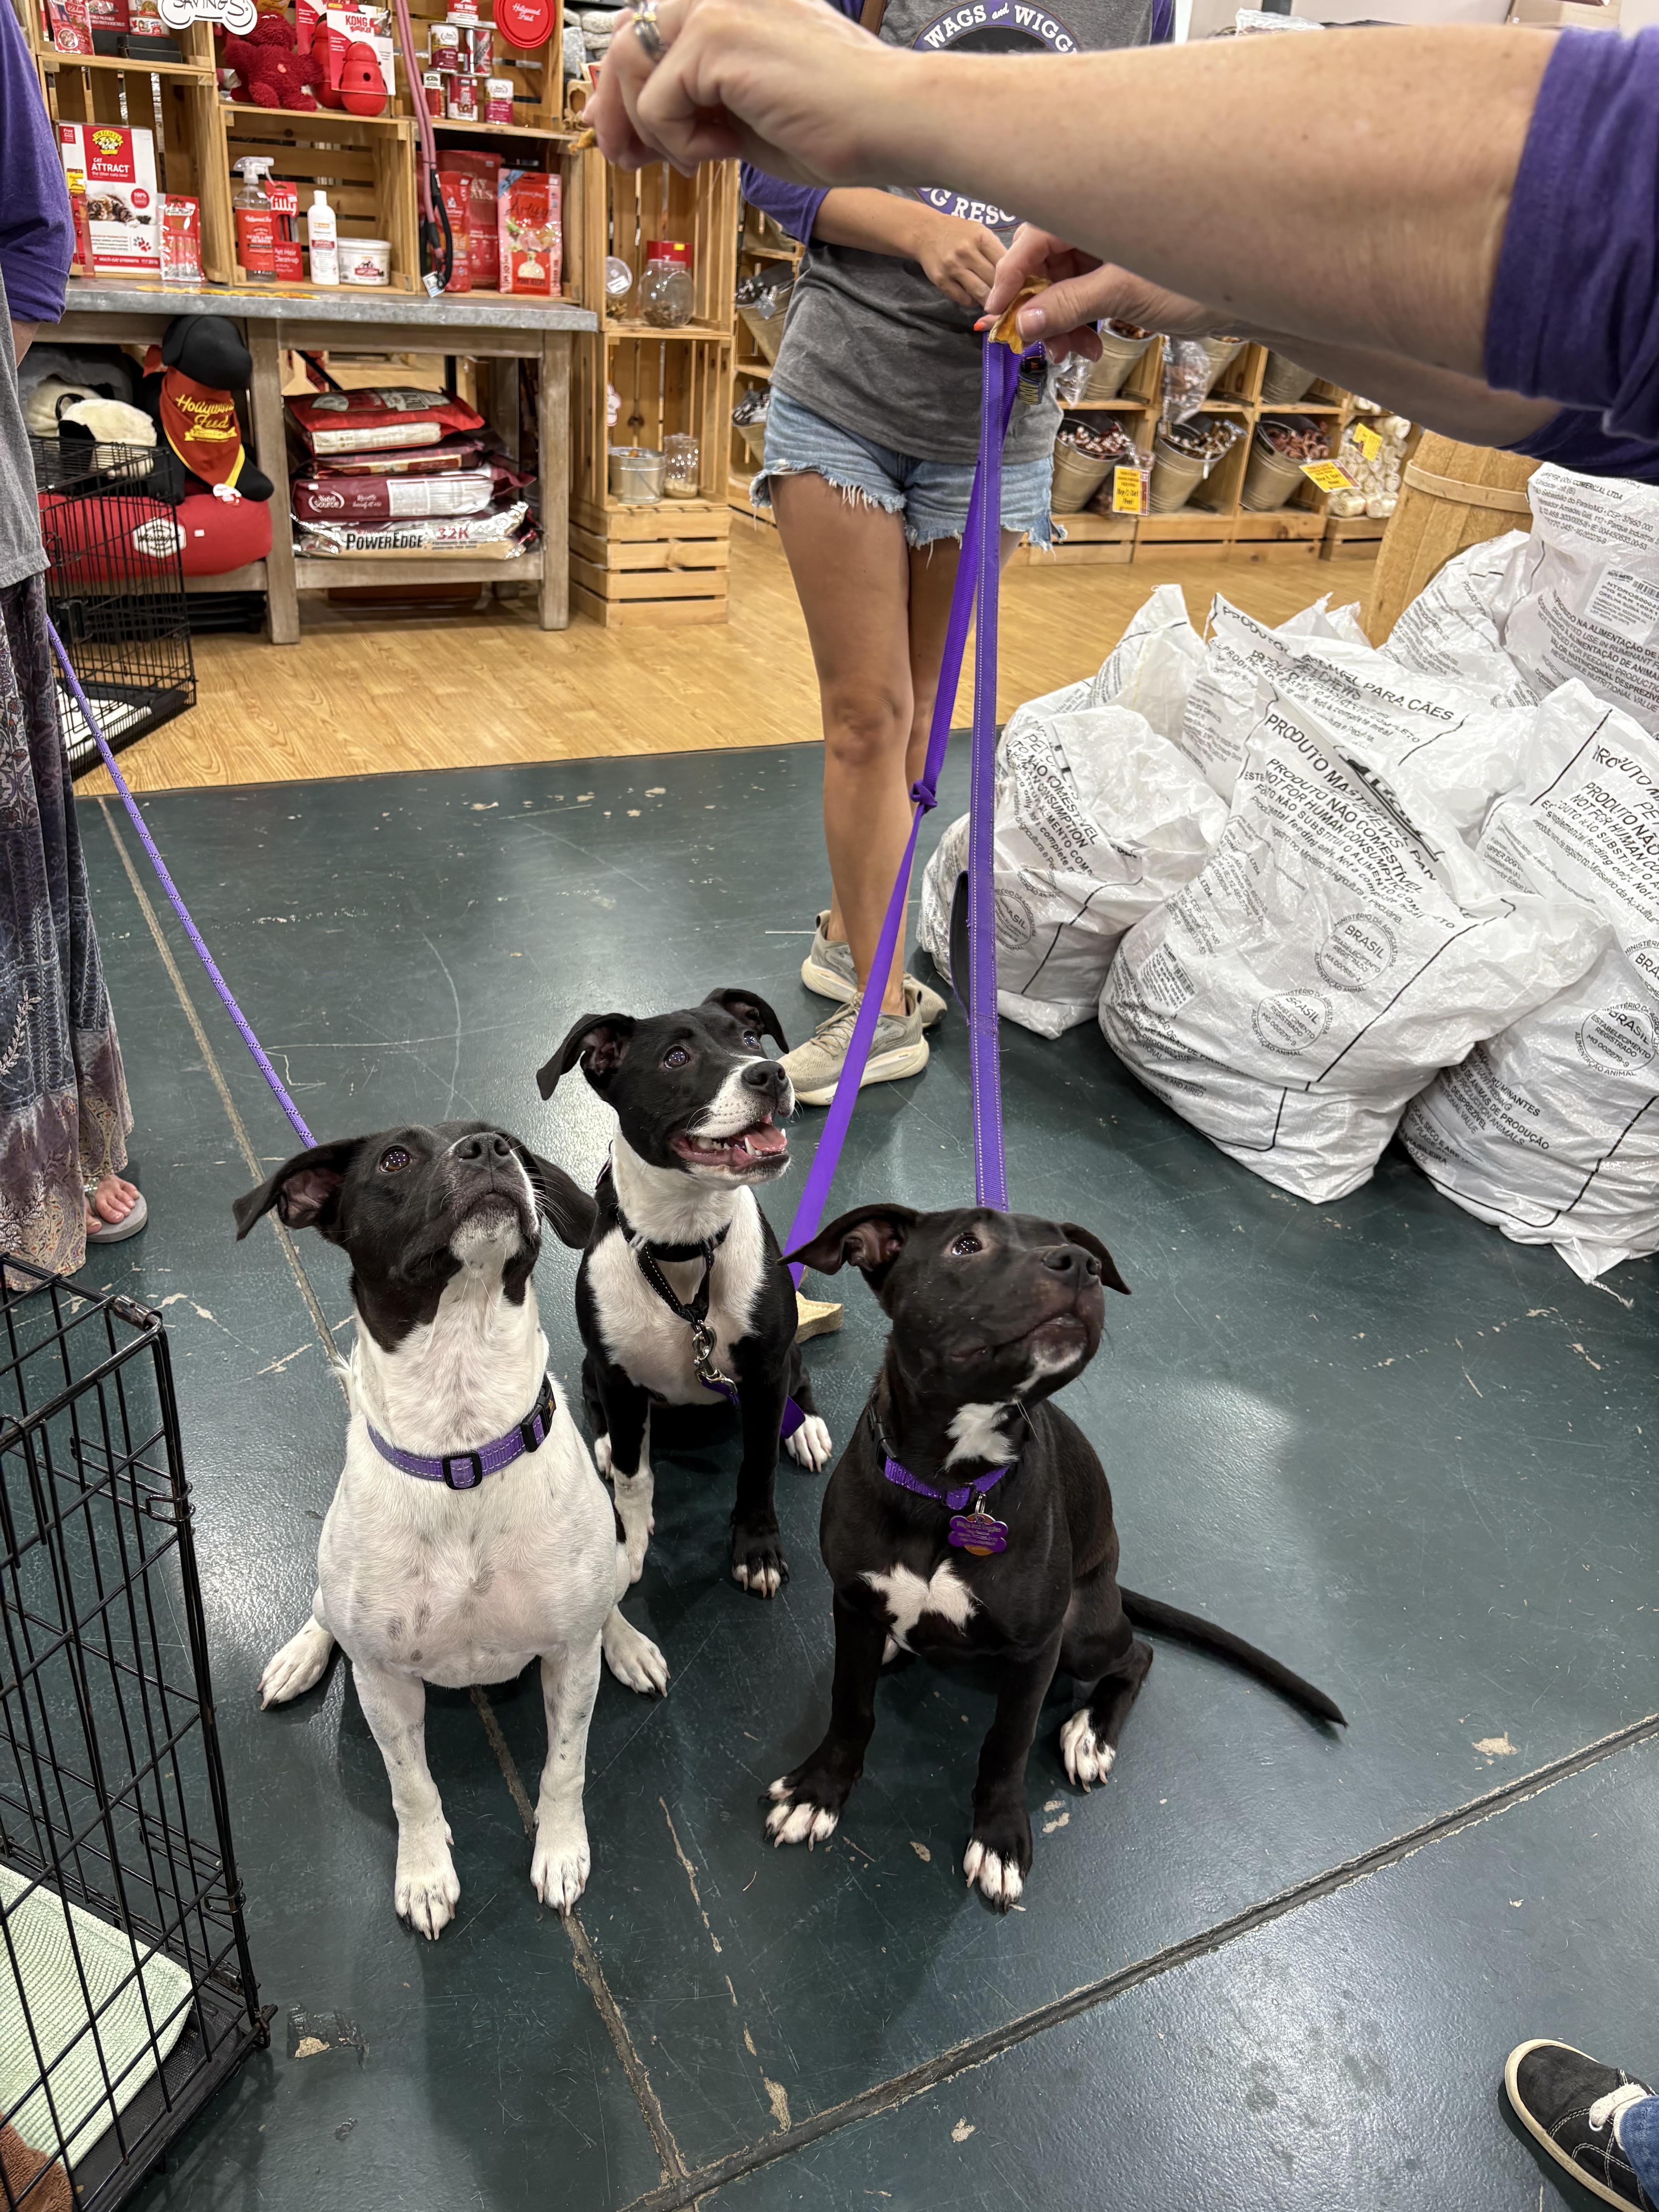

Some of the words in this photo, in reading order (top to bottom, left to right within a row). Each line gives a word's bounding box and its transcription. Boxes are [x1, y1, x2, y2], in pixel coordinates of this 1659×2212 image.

[345, 15, 368, 27] KONG
[512, 3, 541, 15] Hollywood
[924, 5, 987, 48] WAGS
[992, 3, 1009, 19] and
[91, 163, 129, 173] ATTRACT
[194, 414, 229, 428] Feed
[1588, 623, 1643, 653] ALIMENTAÇÃO
[1644, 647, 1657, 658] DE
[1620, 656, 1631, 668] DE
[1407, 698, 1455, 721] CÃES
[1633, 694, 1659, 713] VALUE
[1264, 713, 1329, 771] PRODUTO
[1281, 783, 1307, 803] FOR
[1304, 800, 1348, 833] HUMAN
[1581, 781, 1638, 825] PRODUTO
[1266, 759, 1328, 800] PRODUTO
[1326, 798, 1358, 823] NÃO
[1356, 820, 1423, 891] COMESTÍVEL
[1607, 823, 1648, 861] HUMAN
[1039, 827, 1069, 866] complete
[1275, 794, 1298, 811] NÃO
[1350, 852, 1395, 895] ALIMENTO
[1344, 924, 1385, 960] BRASIL
[1591, 1013, 1651, 1059] ESTABELECIMENTO
[1595, 1026, 1637, 1058] REGISTRADO
[1608, 1009, 1650, 1045] BRASIL
[1575, 1030, 1604, 1072] ALIMENTAÇÃO
[1604, 1068, 1637, 1077] ANIMAL
[1587, 1034, 1598, 1045] MG
[1597, 1041, 1630, 1068] 002279-9
[1450, 1085, 1487, 1131] DESPREZÍVEL
[1470, 1079, 1492, 1106] ANIMAIS
[1489, 1103, 1501, 1116] DE
[1500, 1113, 1550, 1151] PRODUÇÃO
[1491, 1077, 1541, 1117] RUMINANTES
[1423, 1121, 1439, 1142] SECO
[1460, 1111, 1479, 1135] VALUE
[1489, 1118, 1525, 1146] ANIMALS
